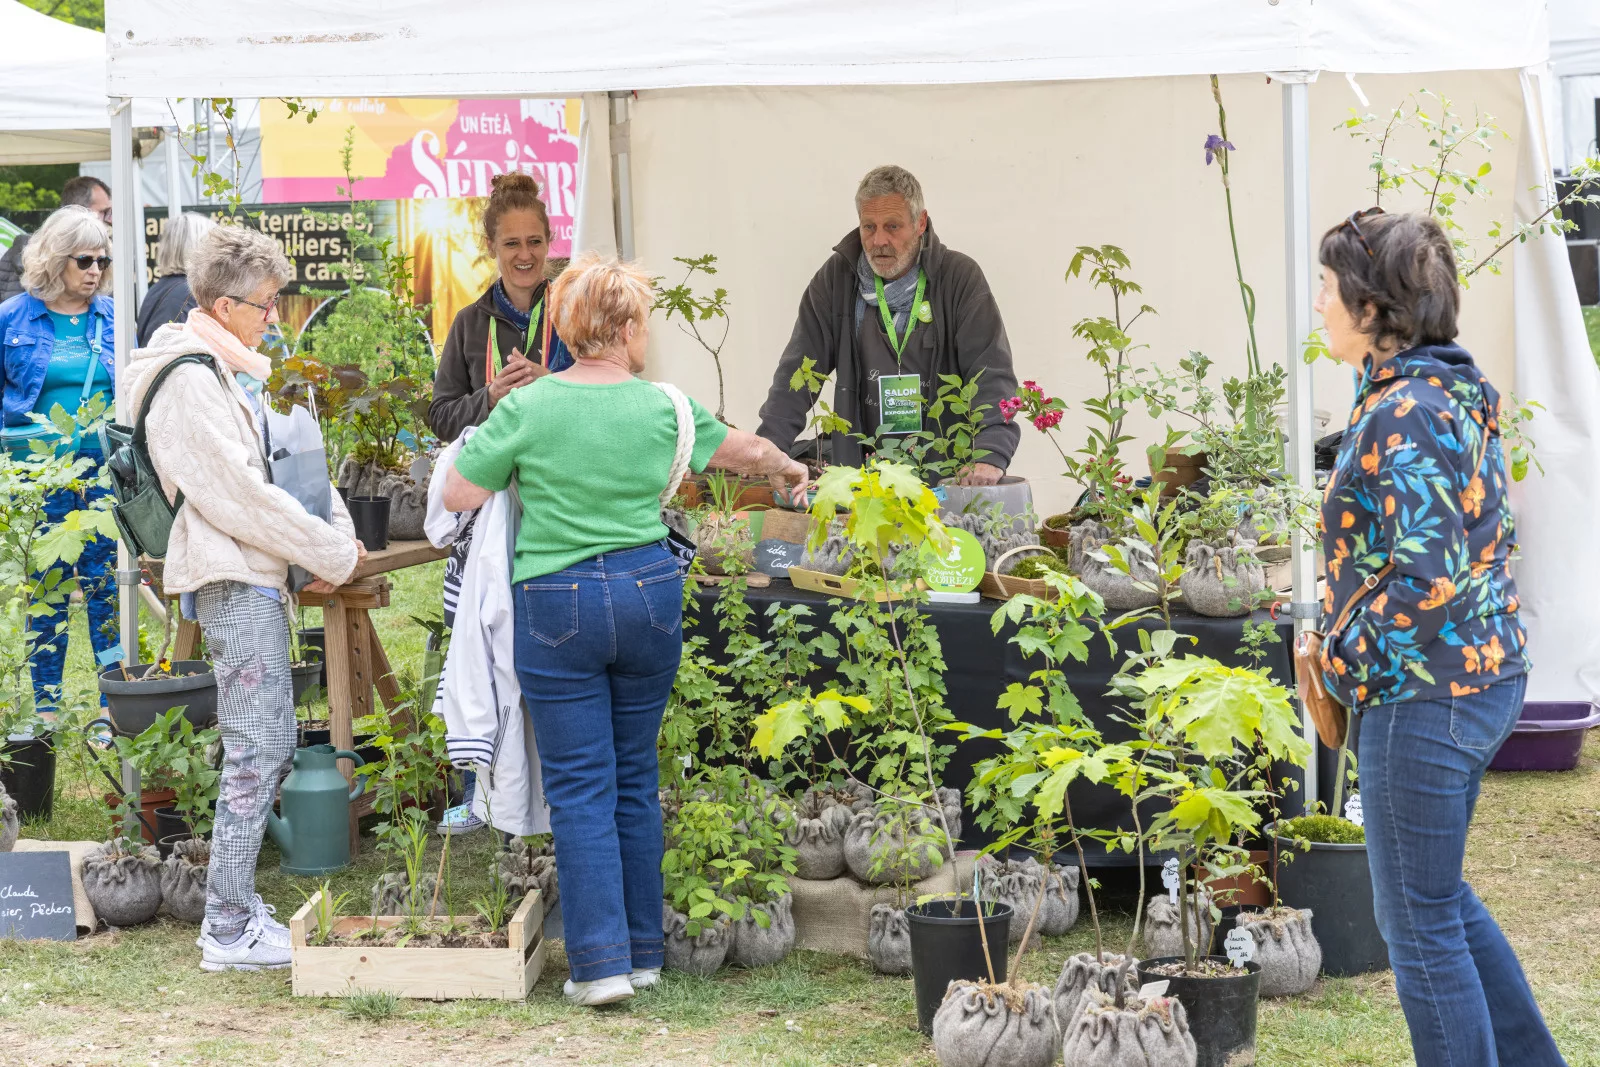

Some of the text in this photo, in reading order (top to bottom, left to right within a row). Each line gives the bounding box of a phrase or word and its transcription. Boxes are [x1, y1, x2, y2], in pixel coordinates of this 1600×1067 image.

[460, 112, 513, 135] UN ÉTÉ À
[259, 210, 373, 234] terrasses,
[884, 387, 917, 397] SALON
[884, 408, 918, 416] EXPOSANT
[766, 544, 787, 557] idée
[0, 885, 39, 899] Claude
[30, 902, 72, 918] Pêchers
